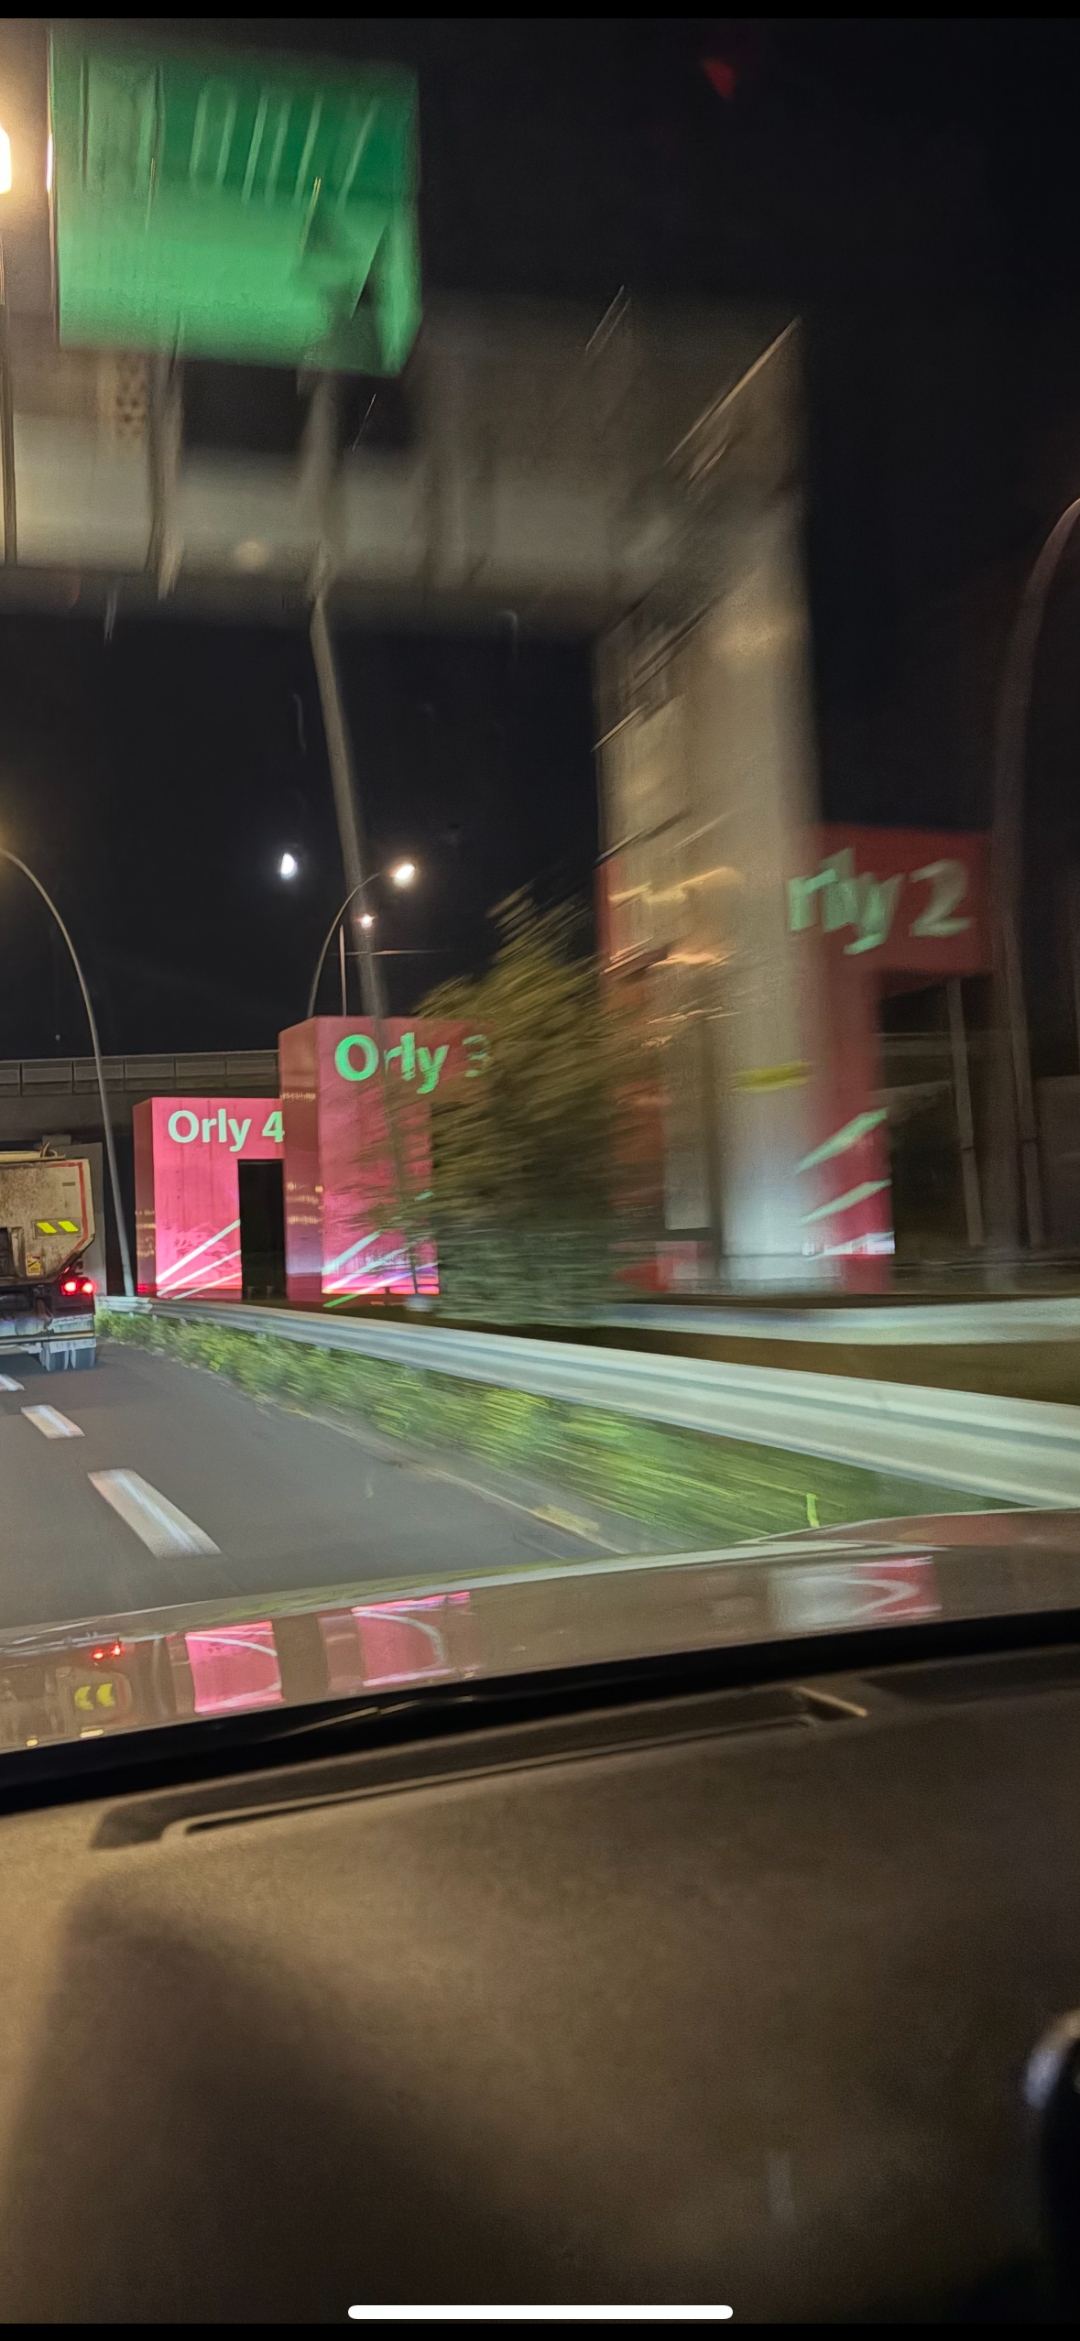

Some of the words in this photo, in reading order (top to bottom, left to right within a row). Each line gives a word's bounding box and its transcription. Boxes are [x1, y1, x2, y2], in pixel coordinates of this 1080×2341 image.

[788, 848, 905, 954] rly
[910, 859, 972, 937] 2
[335, 1032, 449, 1094] Orly
[168, 1109, 251, 1152] Orly
[262, 1111, 285, 1142] 4
